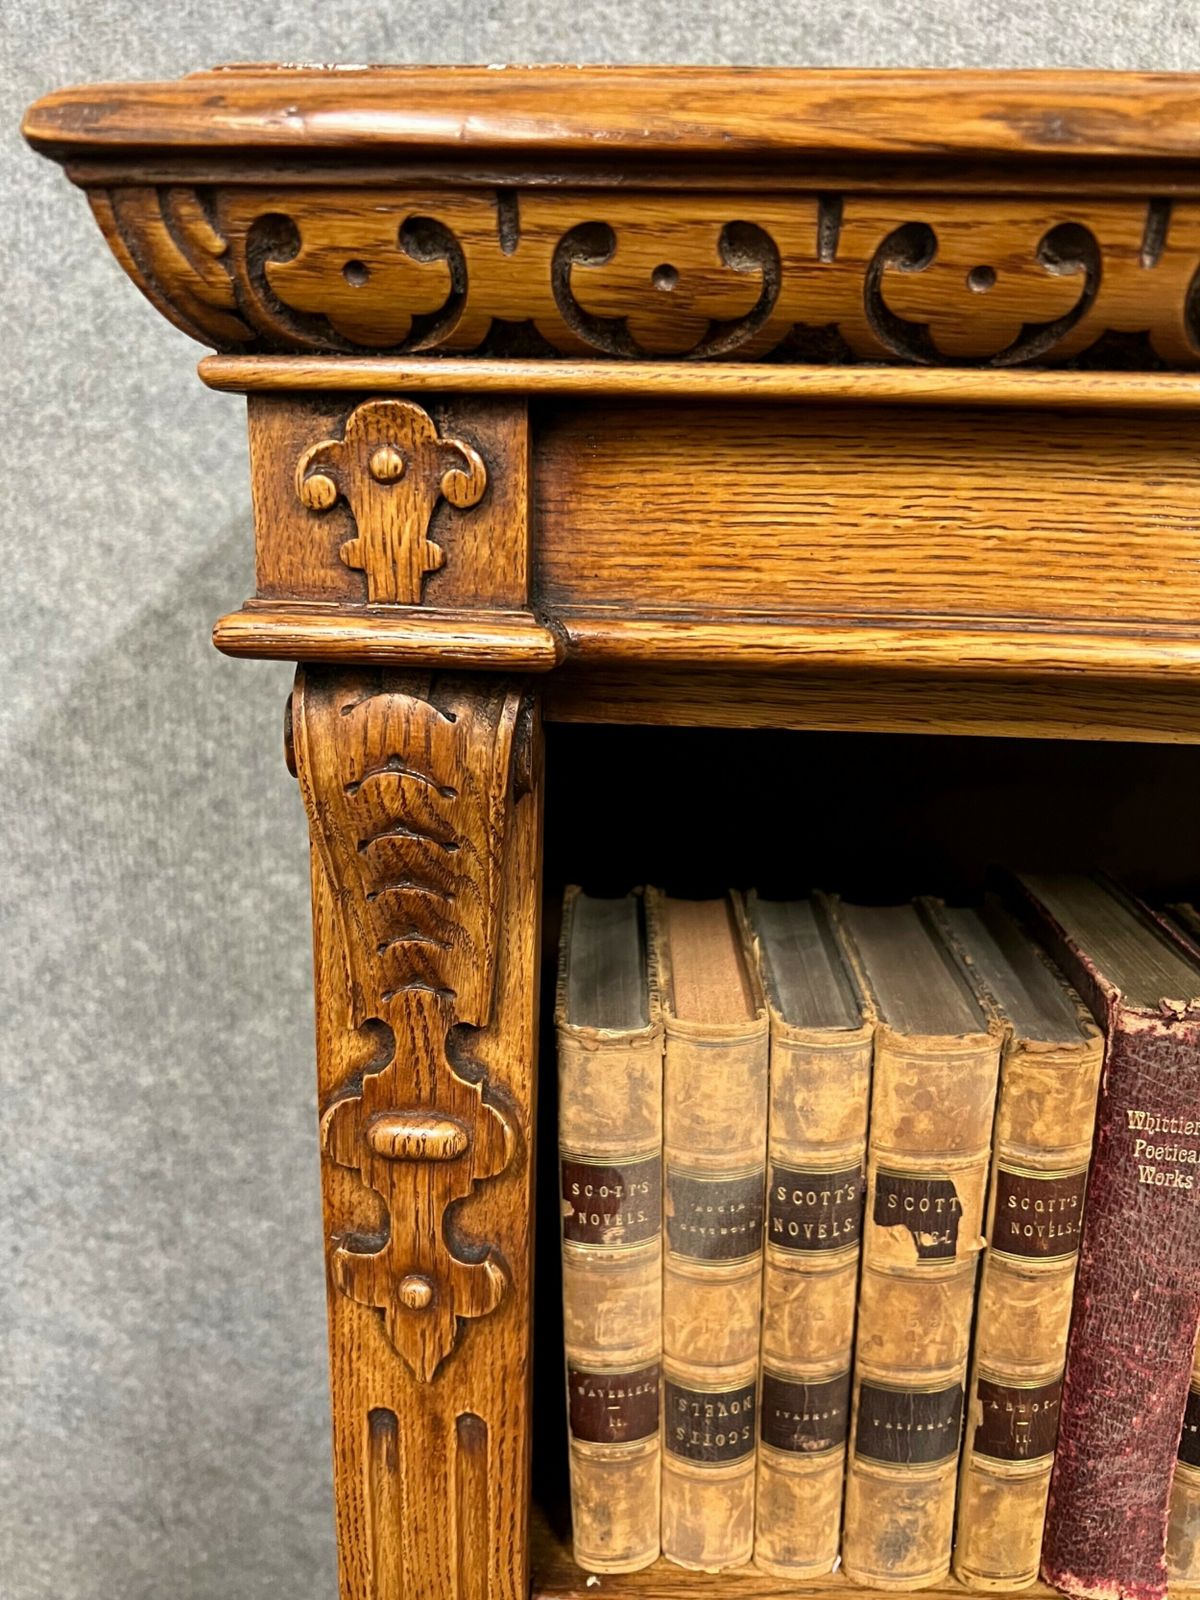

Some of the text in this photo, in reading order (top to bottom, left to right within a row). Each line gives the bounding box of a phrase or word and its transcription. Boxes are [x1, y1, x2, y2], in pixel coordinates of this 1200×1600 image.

[1126, 1109, 1200, 1136] Whittier
[1137, 1164, 1194, 1189] Works
[571, 1181, 650, 1198] SCOTT'S
[777, 1184, 856, 1206] SCOTT'S
[1007, 1195, 1078, 1213] SCOTT'S
[676, 1426, 751, 1448] SCOTT'S
